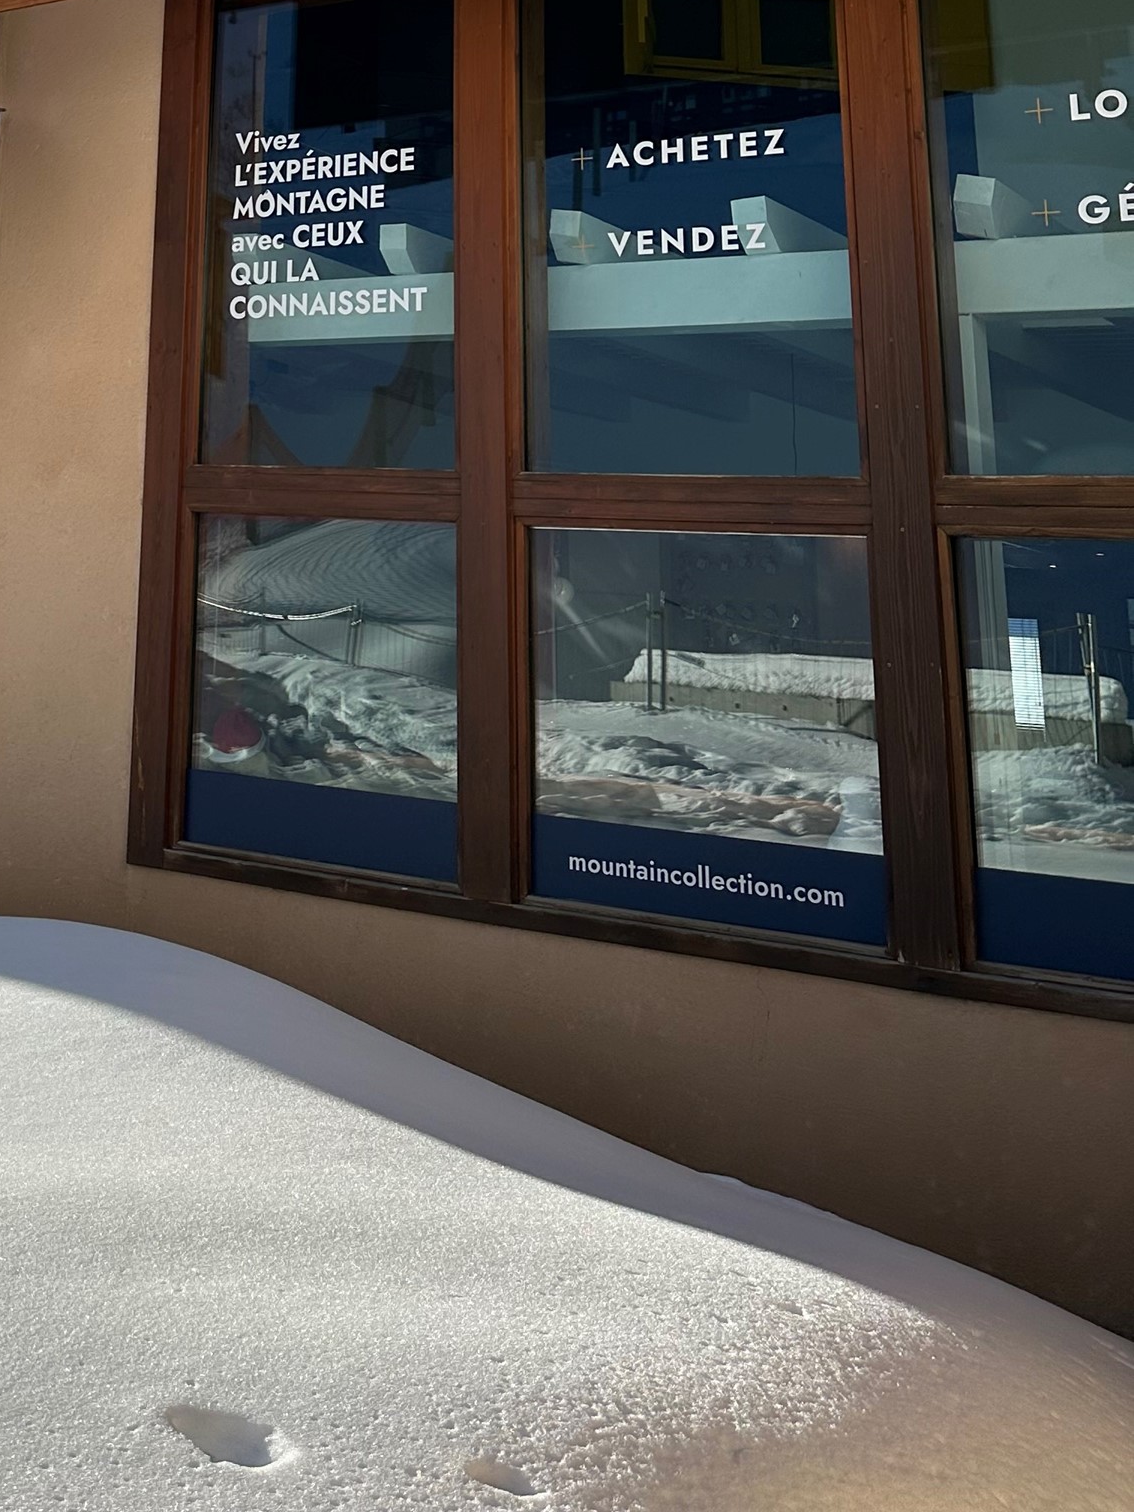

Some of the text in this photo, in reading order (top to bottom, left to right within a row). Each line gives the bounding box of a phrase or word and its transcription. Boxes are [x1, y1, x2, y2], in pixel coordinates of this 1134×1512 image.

[235, 130, 301, 155] Vivez
[605, 128, 785, 169] ACHETEZ
[234, 147, 416, 187] L'EXPÉRIENCE
[232, 184, 385, 220] MONTAGNE
[231, 220, 365, 253] avec CEUX
[607, 222, 766, 258] VENDEZ
[230, 257, 320, 286] QUI LA
[229, 286, 428, 320] CONNAISSENT
[568, 854, 845, 908] mountaincollection.com
